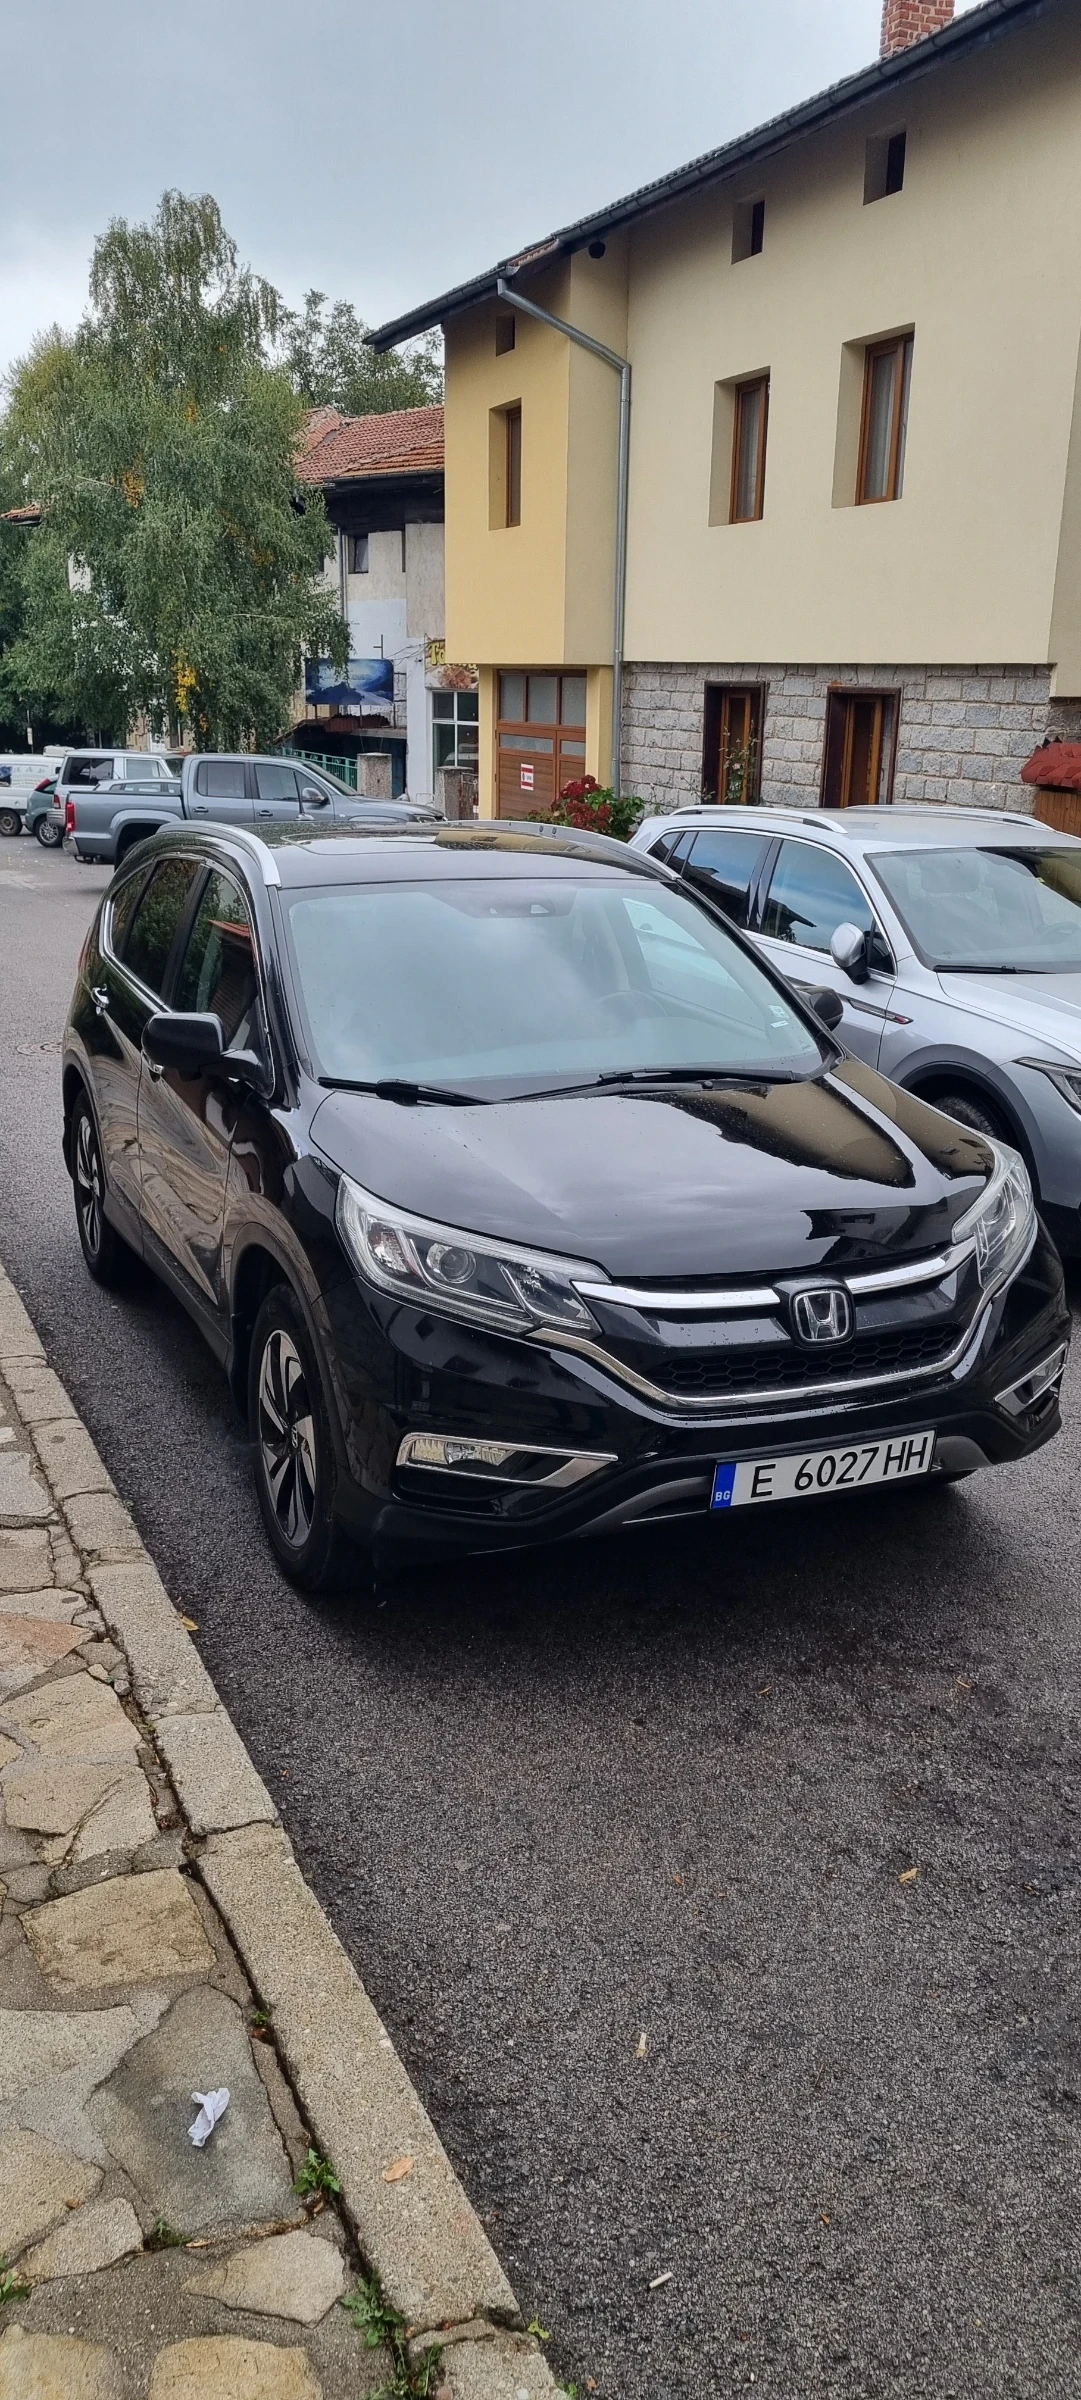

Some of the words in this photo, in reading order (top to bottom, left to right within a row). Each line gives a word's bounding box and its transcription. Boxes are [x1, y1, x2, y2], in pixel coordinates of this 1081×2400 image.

[750, 1463, 776, 1499] E
[794, 1446, 880, 1491] 6027
[882, 1436, 929, 1476] HH
[715, 1490, 731, 1501] BG
